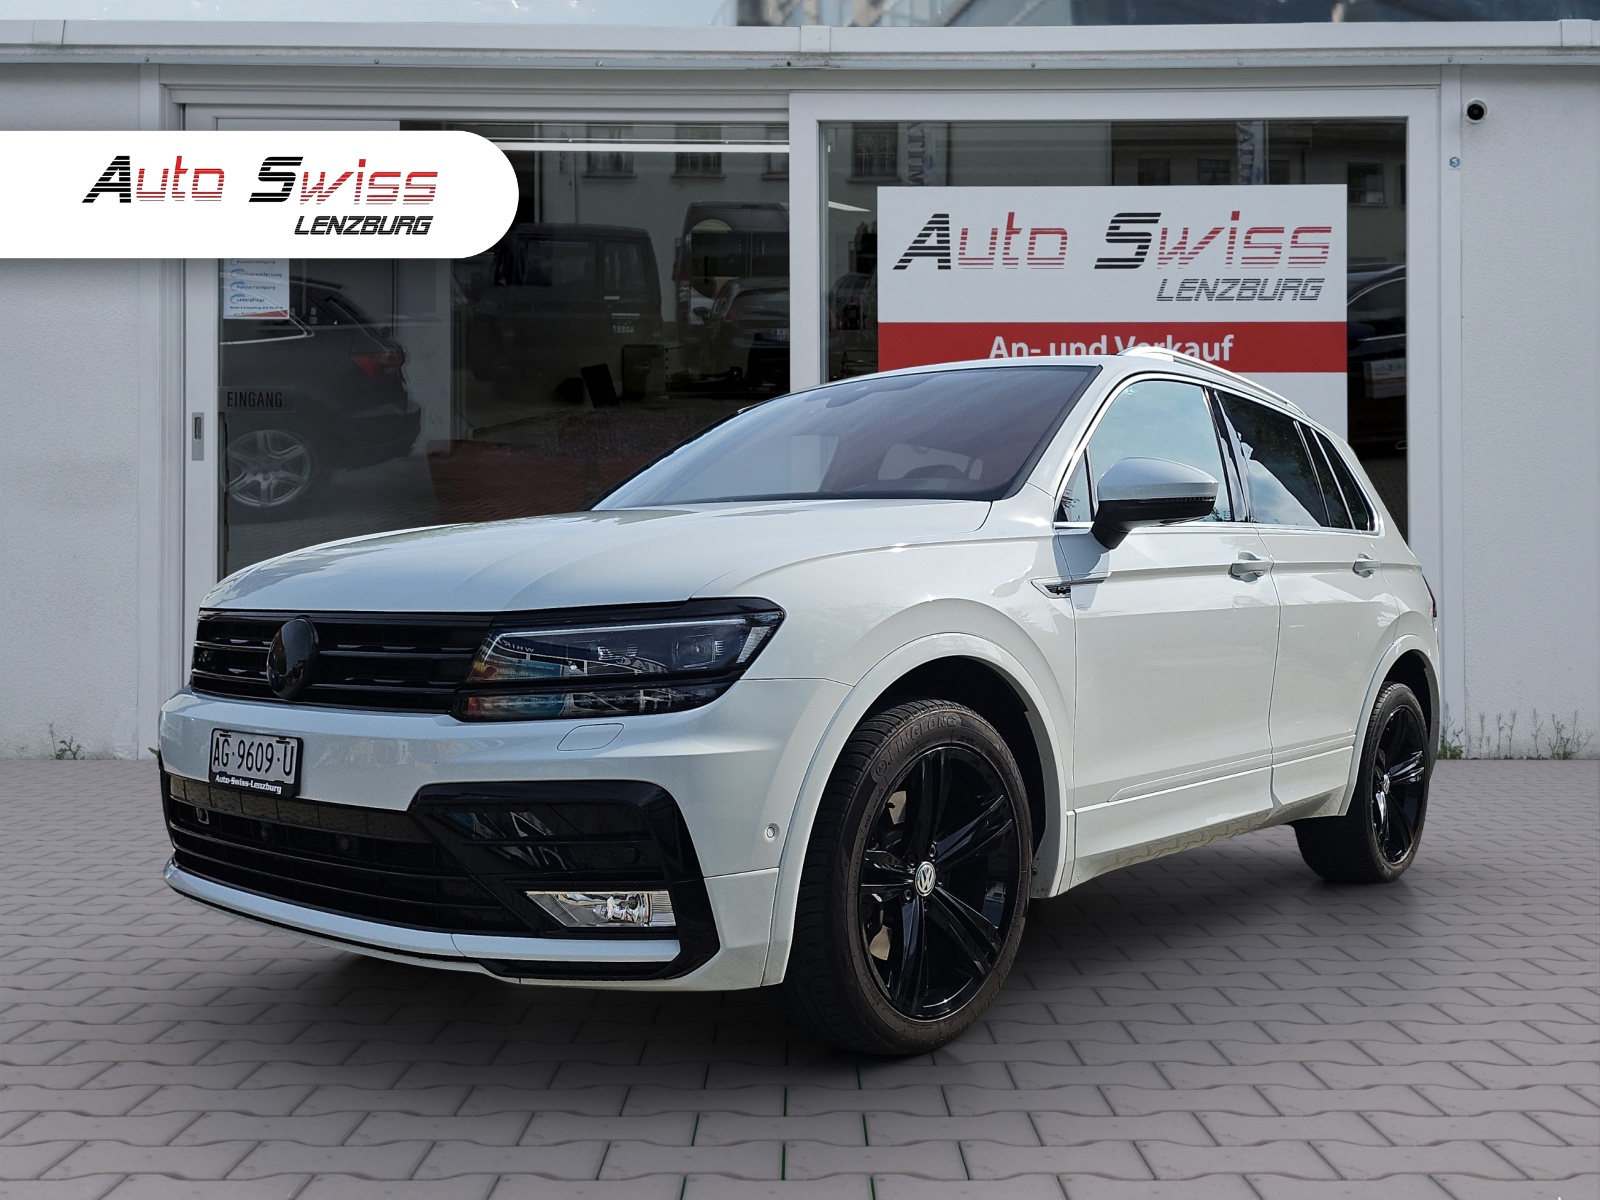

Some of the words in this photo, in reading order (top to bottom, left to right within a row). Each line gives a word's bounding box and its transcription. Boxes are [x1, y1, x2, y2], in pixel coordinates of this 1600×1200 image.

[892, 211, 1067, 270] Auto
[1093, 210, 1332, 270] Swiss
[1156, 277, 1325, 302] LENZBURG
[989, 336, 1041, 359] An-
[1049, 335, 1108, 356] und
[1114, 334, 1235, 362] Vkauf
[226, 391, 283, 408] EINGANG
